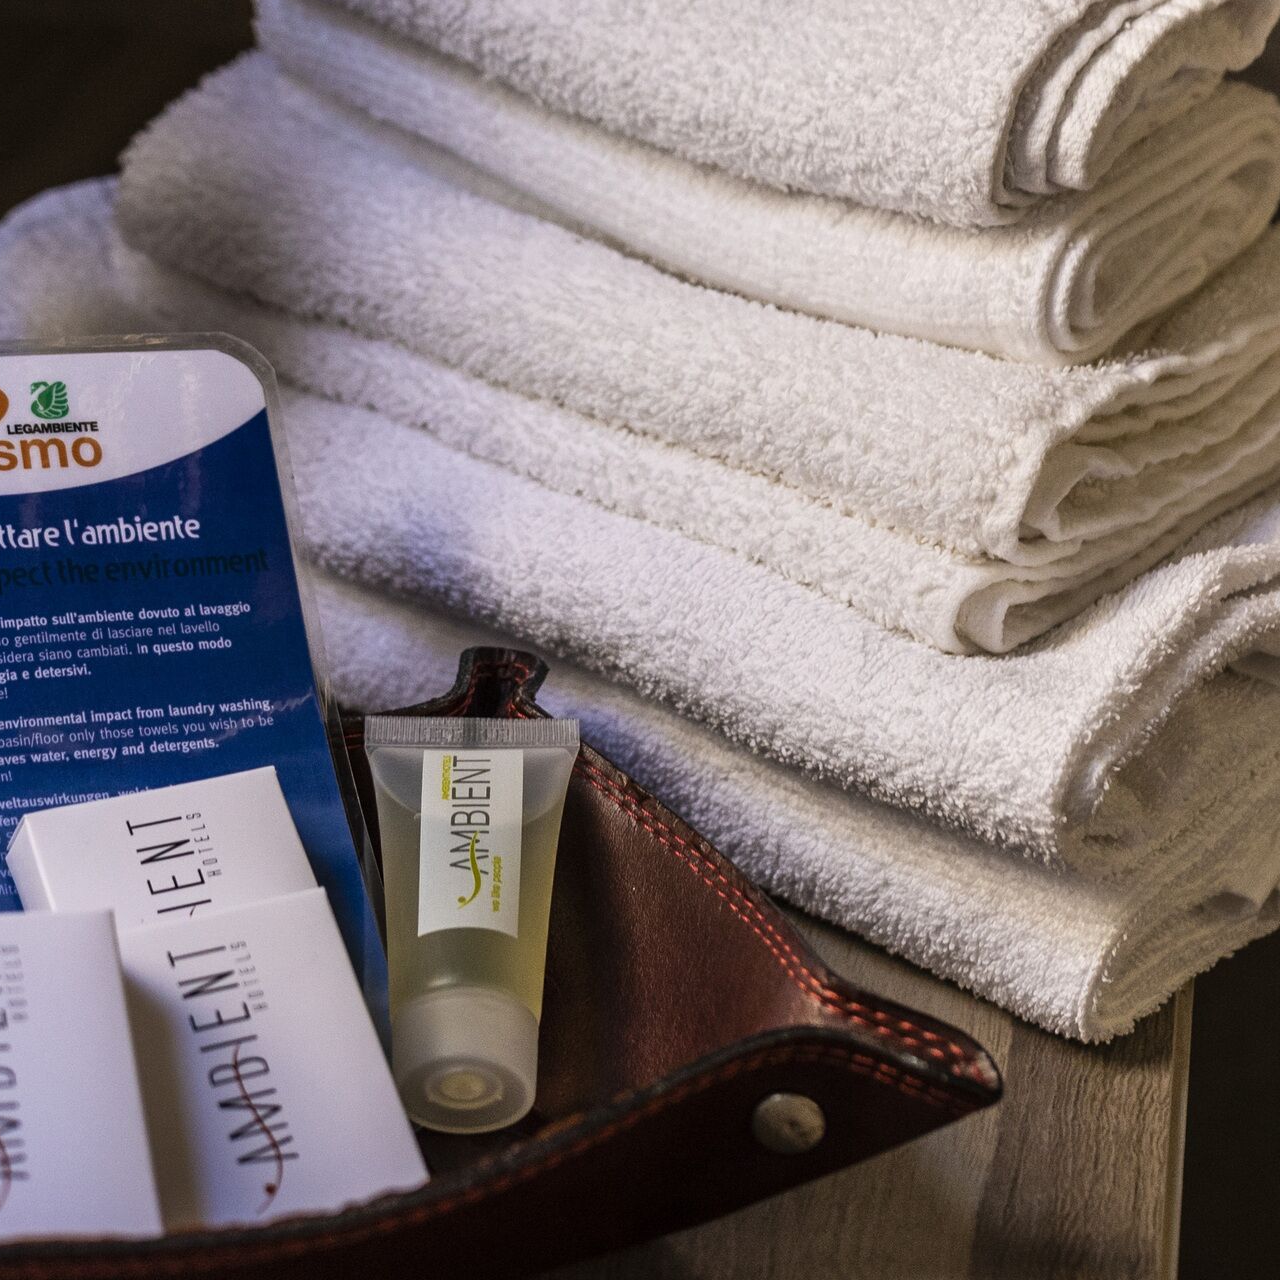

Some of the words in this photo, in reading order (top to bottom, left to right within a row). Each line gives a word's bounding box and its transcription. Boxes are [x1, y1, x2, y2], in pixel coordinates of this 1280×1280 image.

[6, 421, 99, 436] LEGAMBIENTE
[63, 515, 201, 545] l'ambiente
[54, 556, 99, 584] the
[104, 547, 268, 582] environment
[51, 610, 135, 625] sull'ambiente
[137, 608, 181, 620] dovuto
[183, 604, 197, 616] al
[198, 601, 251, 616] lavaggio
[13, 631, 87, 648] gentilmente
[91, 628, 104, 640] di
[107, 626, 153, 638] lasciare
[157, 624, 177, 635] nel
[180, 621, 220, 634] lavello
[38, 649, 73, 661] siano
[76, 644, 133, 658] cambiati.
[136, 644, 149, 654] In
[152, 640, 195, 655] questo
[197, 637, 233, 649] modo
[21, 670, 30, 680] e
[33, 664, 92, 678] detersivi.
[89, 709, 133, 724] impact
[135, 707, 165, 718] from
[167, 702, 215, 716] laundry
[219, 698, 275, 714] washing,
[68, 729, 95, 743] only
[99, 727, 135, 739] those
[138, 722, 179, 736] towels
[182, 723, 206, 735] you
[209, 718, 238, 730] wish
[241, 717, 255, 728] to
[257, 715, 274, 726] be
[29, 751, 70, 762] water,
[73, 747, 118, 760] energy
[121, 742, 145, 756] and
[149, 738, 220, 753] detergents.
[449, 756, 491, 876] AMBIENT
[185, 812, 222, 877] HOTELS
[167, 946, 300, 1165] AMBIENT
